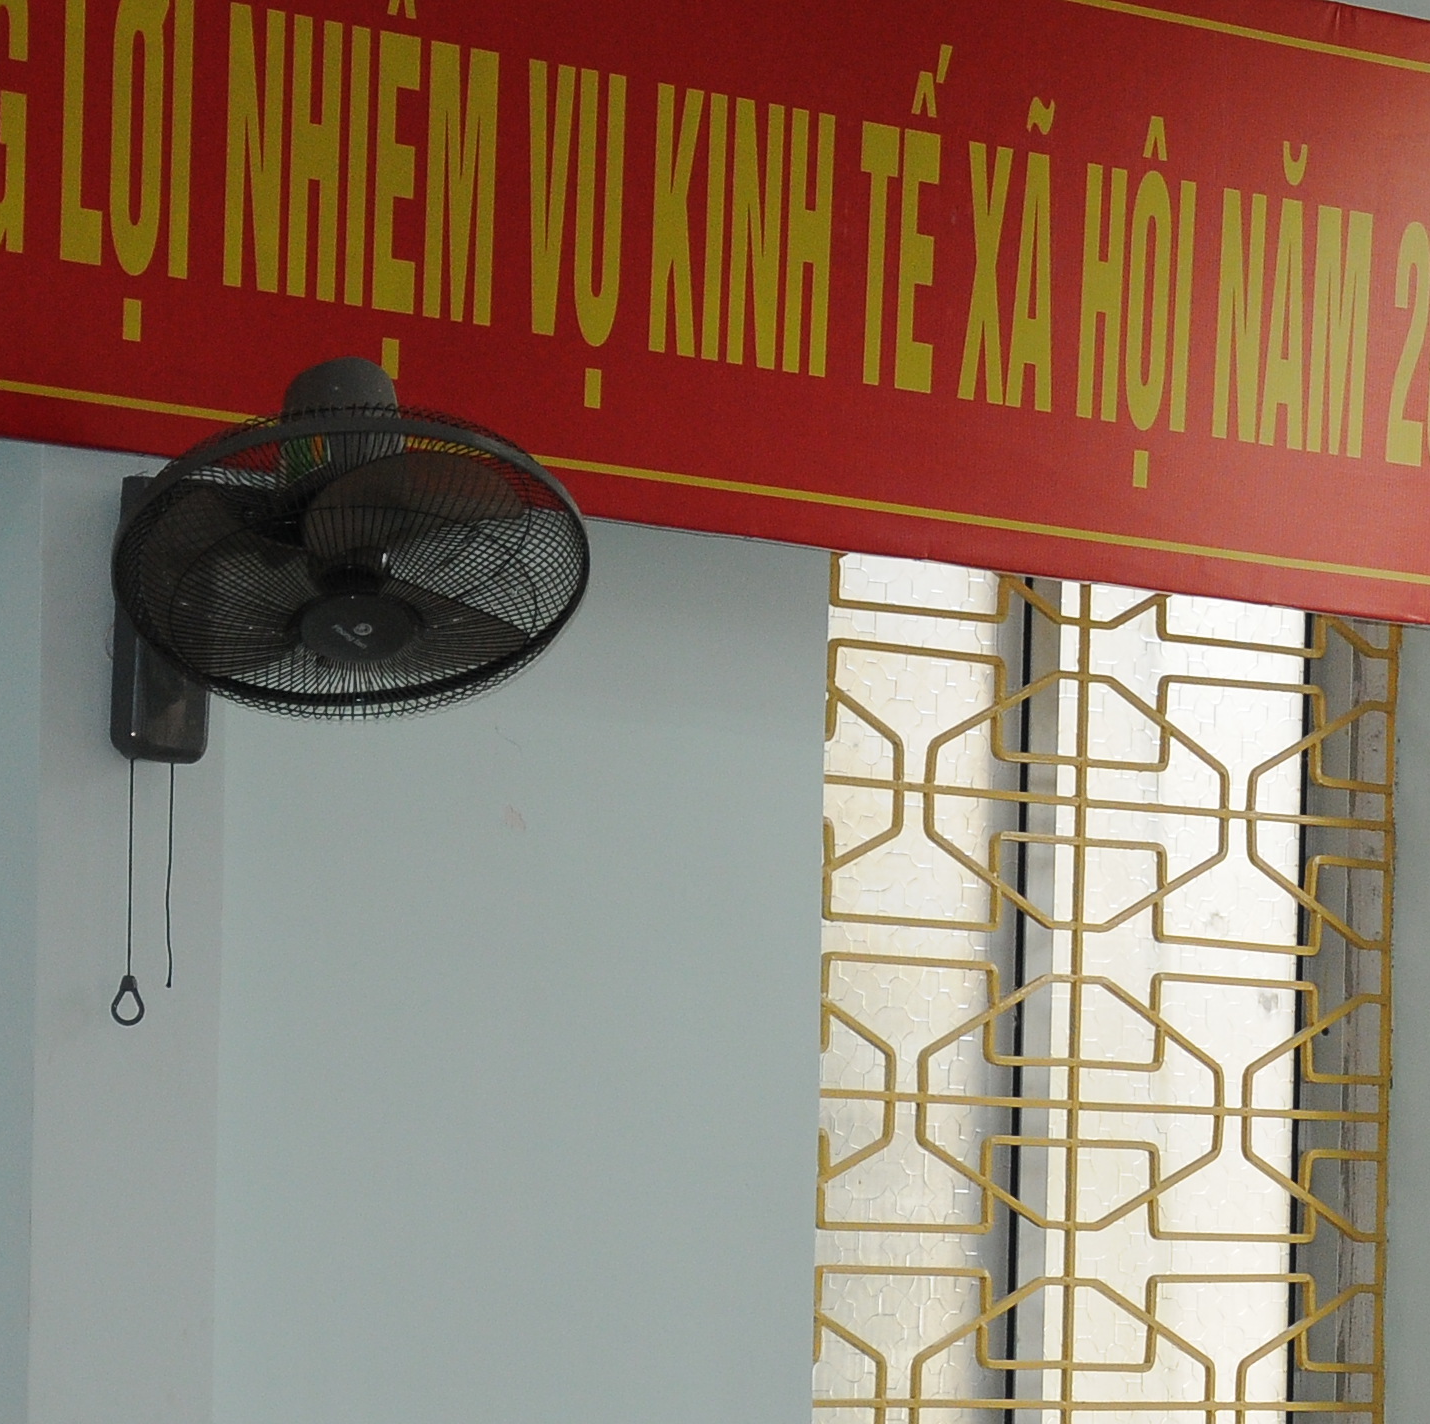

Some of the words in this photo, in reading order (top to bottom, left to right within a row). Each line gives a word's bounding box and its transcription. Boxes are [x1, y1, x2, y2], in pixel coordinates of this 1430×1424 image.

[224, 0, 500, 380] NHIỆM
[530, 60, 627, 409] VỤ
[649, 84, 836, 377] KINH
[859, 45, 953, 394] TẾ
[958, 98, 1056, 413] XÃ
[1077, 116, 1198, 489] HỘI
[1212, 142, 1375, 458] NĂM
